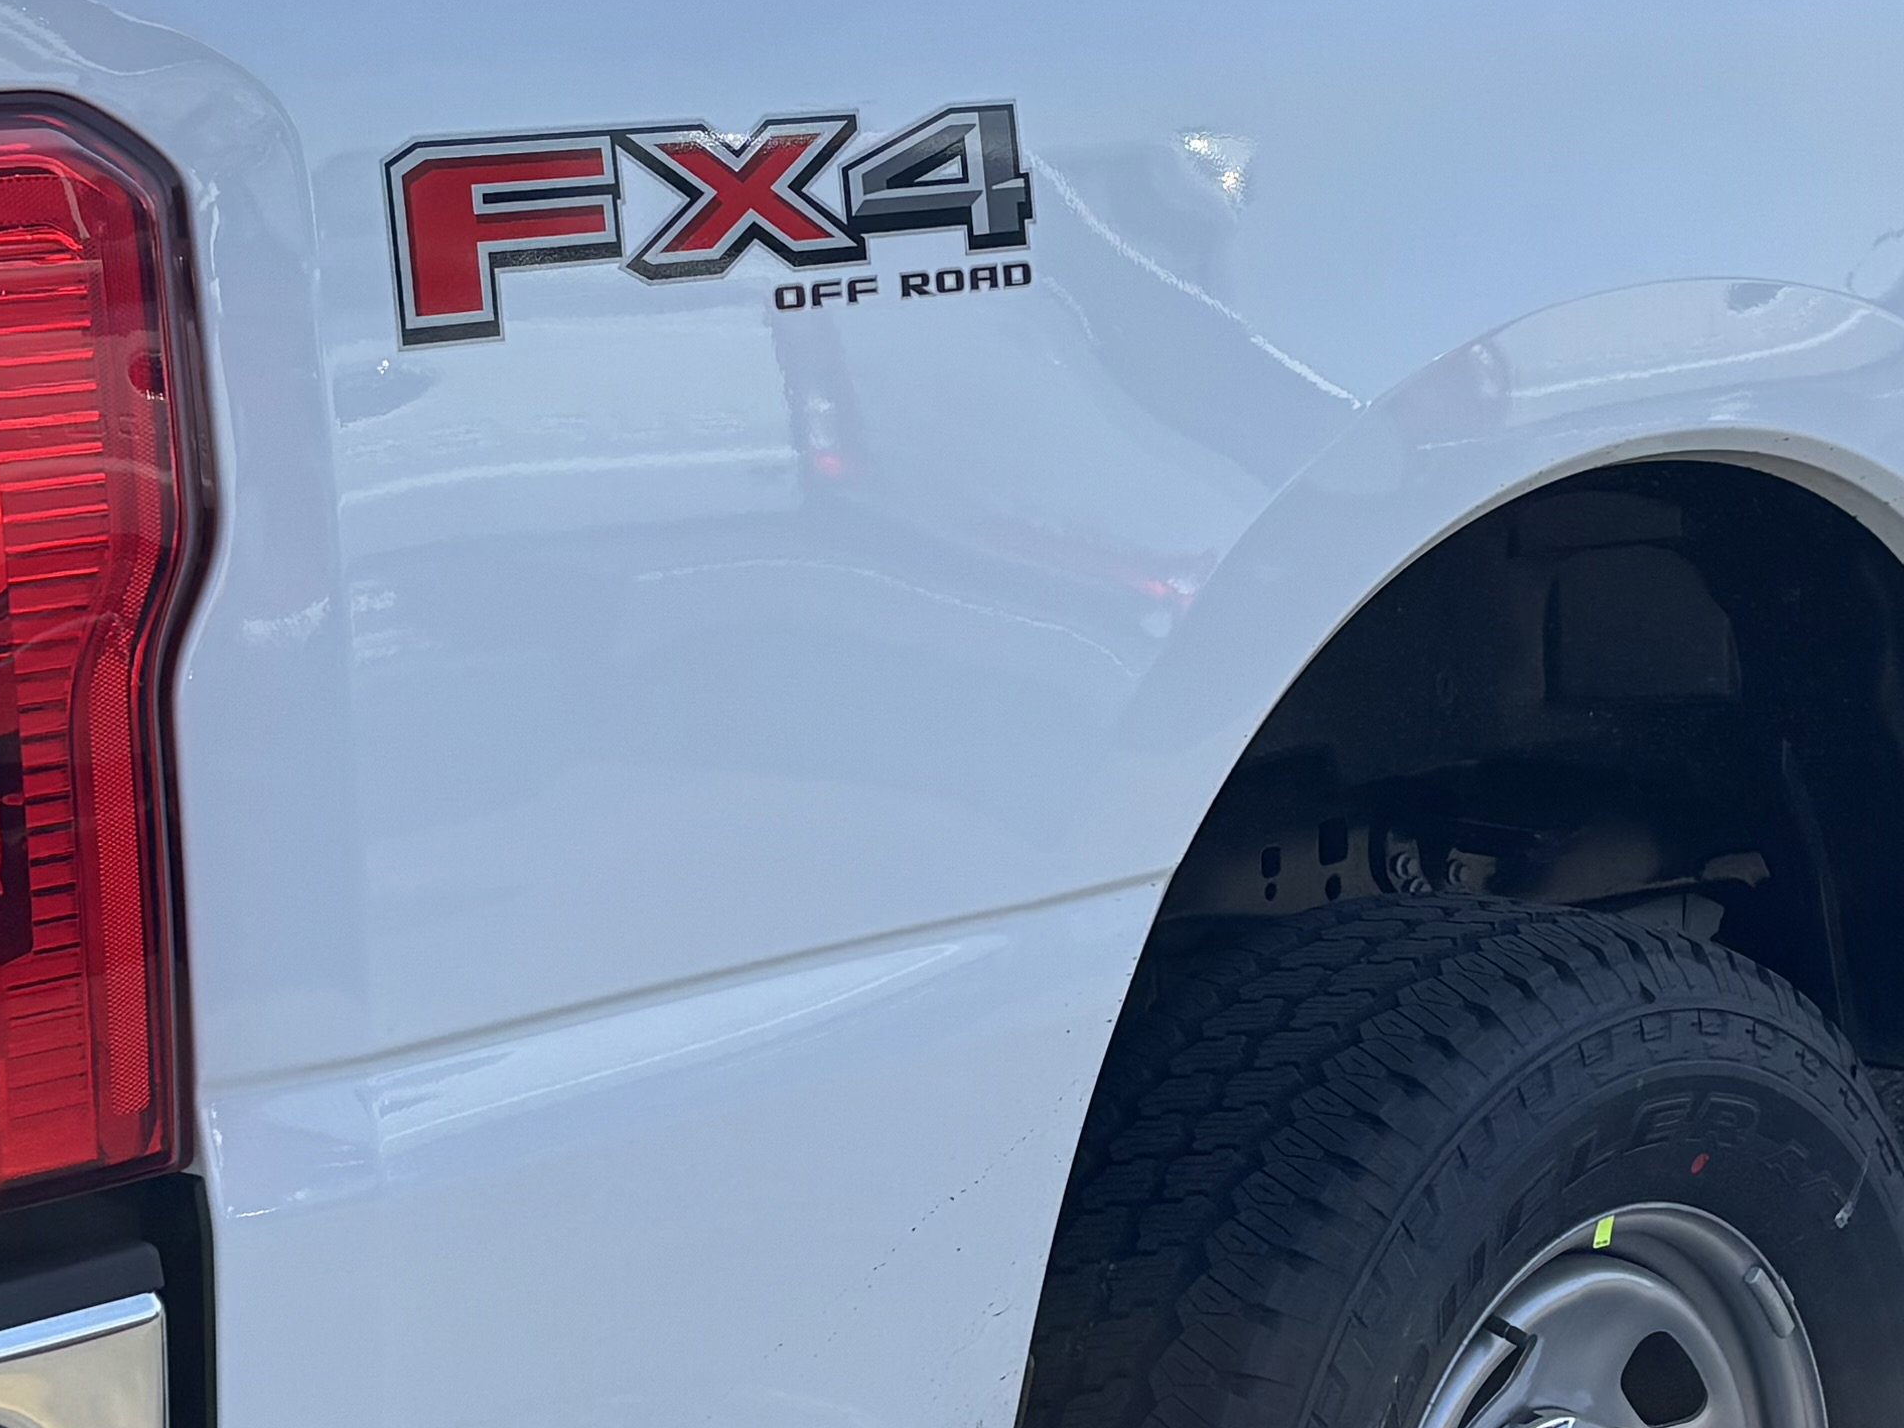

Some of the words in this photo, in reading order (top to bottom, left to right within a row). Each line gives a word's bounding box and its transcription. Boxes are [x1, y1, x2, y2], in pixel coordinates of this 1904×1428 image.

[380, 99, 1036, 350] FX4
[773, 274, 879, 312] OFF
[899, 261, 1034, 300] ROAD
